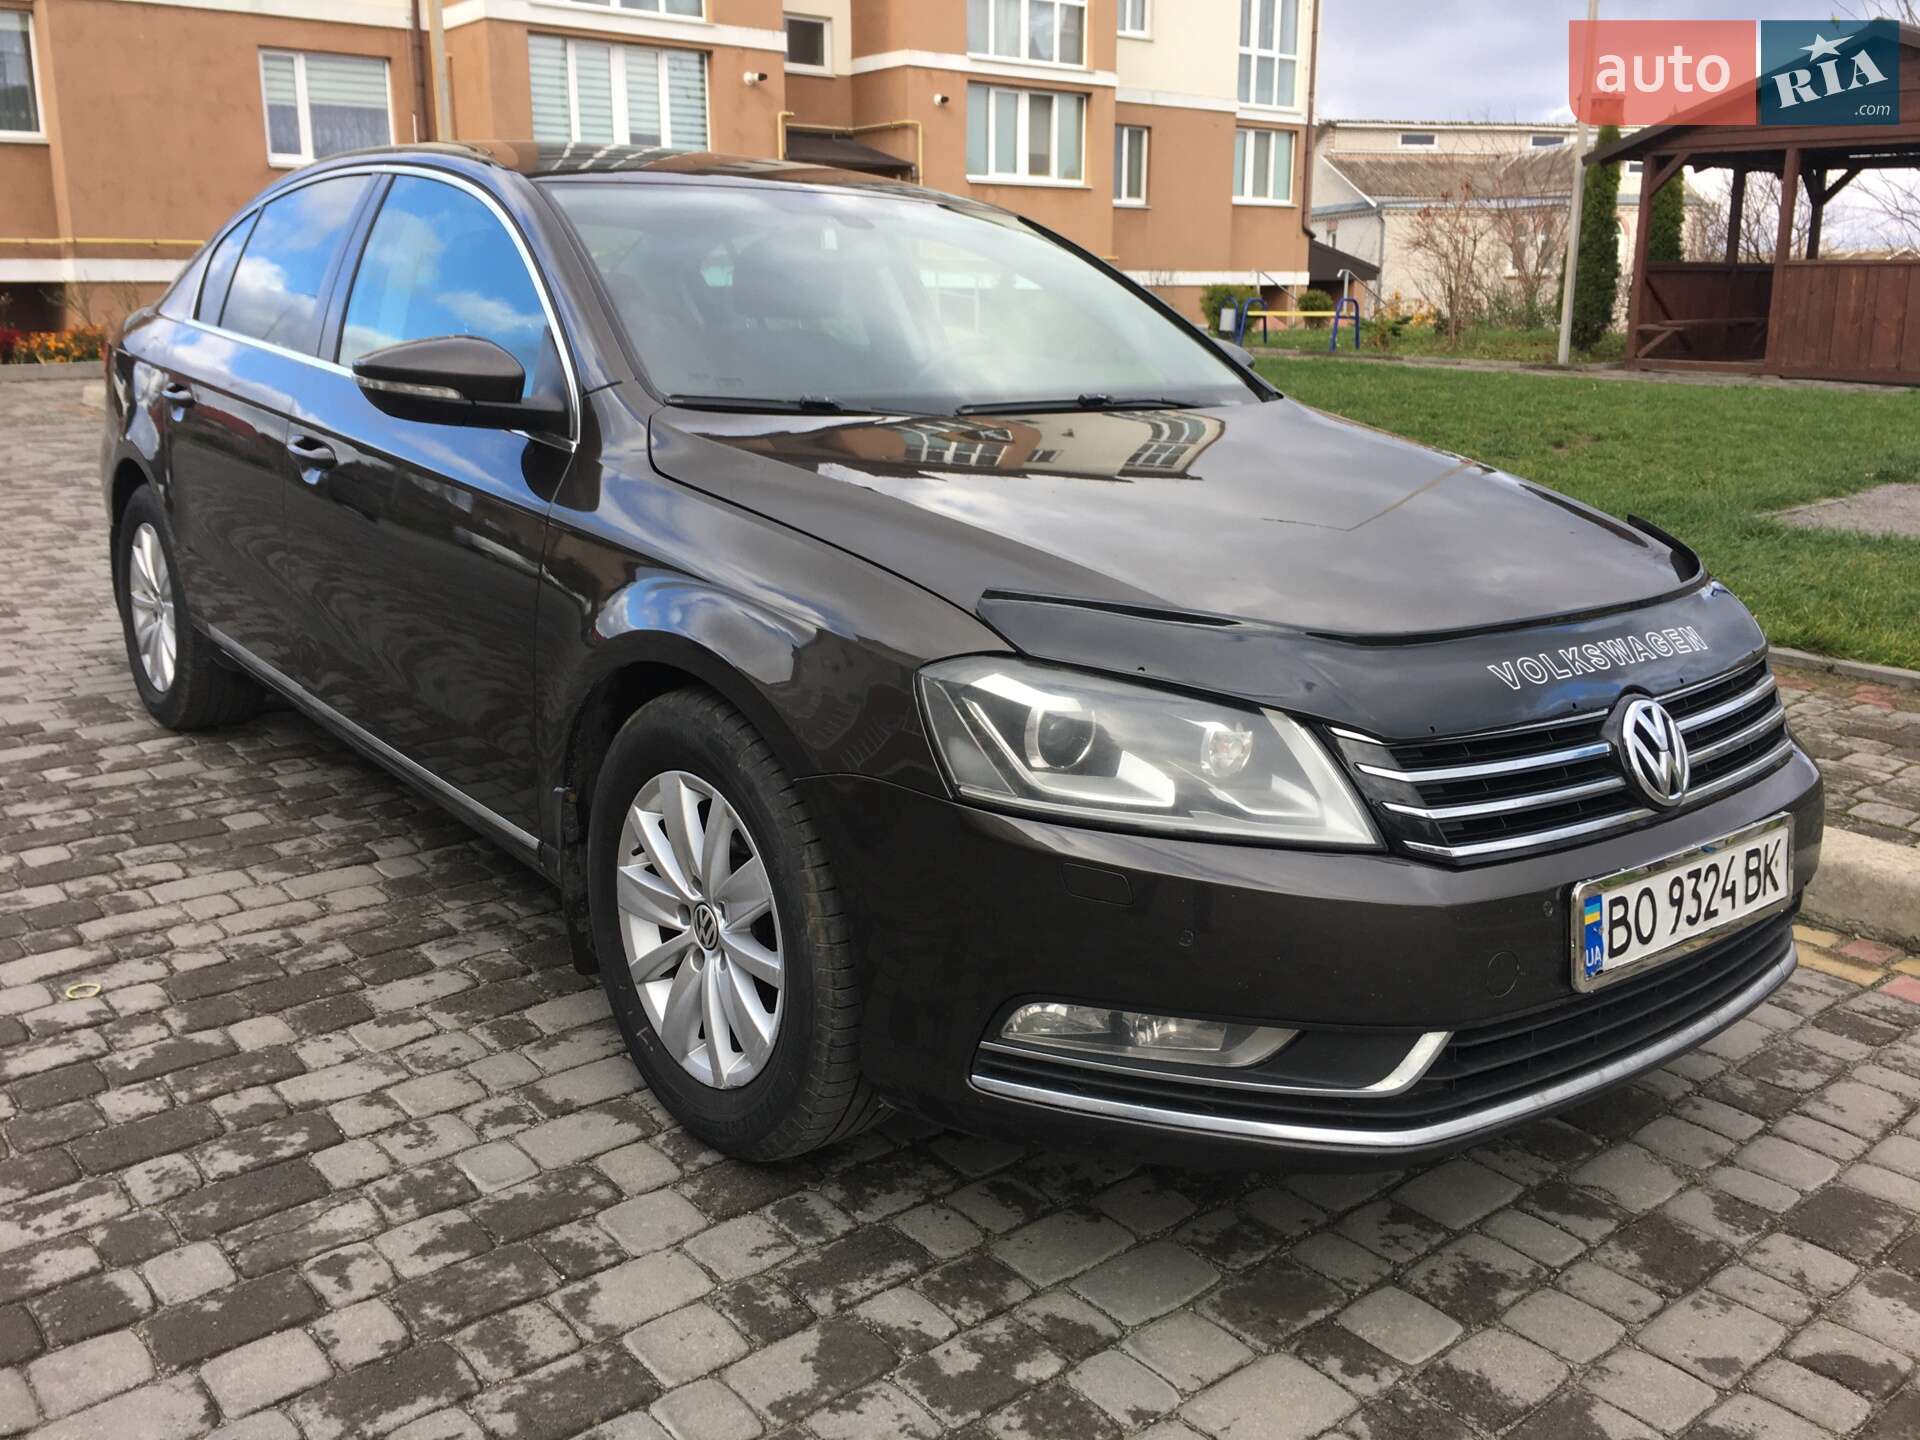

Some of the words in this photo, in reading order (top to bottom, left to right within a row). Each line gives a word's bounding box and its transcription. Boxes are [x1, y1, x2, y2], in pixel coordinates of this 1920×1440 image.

[1487, 626, 1708, 690] VOLKSWAGEN
[1607, 887, 1657, 959] BO
[1668, 855, 1736, 936] 9324
[1744, 838, 1782, 905] BK
[1585, 946, 1602, 967] UA
